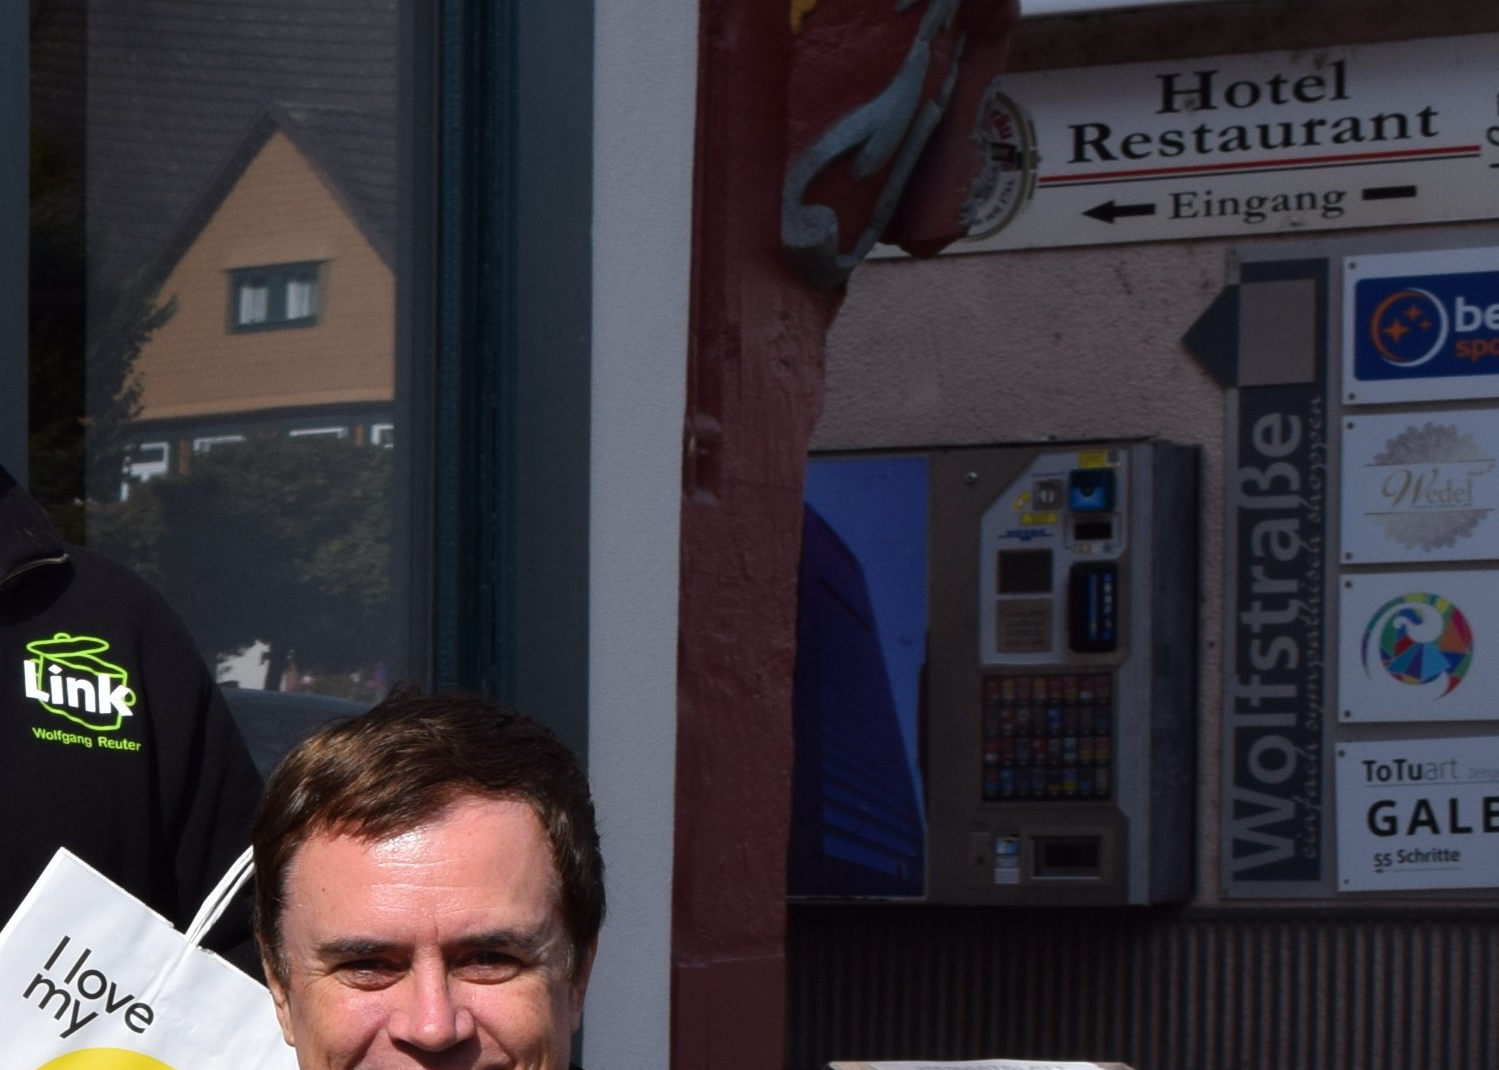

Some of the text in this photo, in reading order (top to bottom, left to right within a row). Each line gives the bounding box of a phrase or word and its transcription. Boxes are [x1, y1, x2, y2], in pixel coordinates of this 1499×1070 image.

[1155, 60, 1350, 114] Hotel
[1068, 106, 1440, 164] Restaurant
[1169, 187, 1348, 225] Eingang
[1233, 411, 1302, 876] Wolfstraße
[24, 660, 134, 717] Link
[32, 727, 141, 751] Wolfgang Reuter
[1374, 848, 1460, 867] 55 Schritte
[23, 973, 99, 1039] my
[43, 935, 154, 1034] I love
